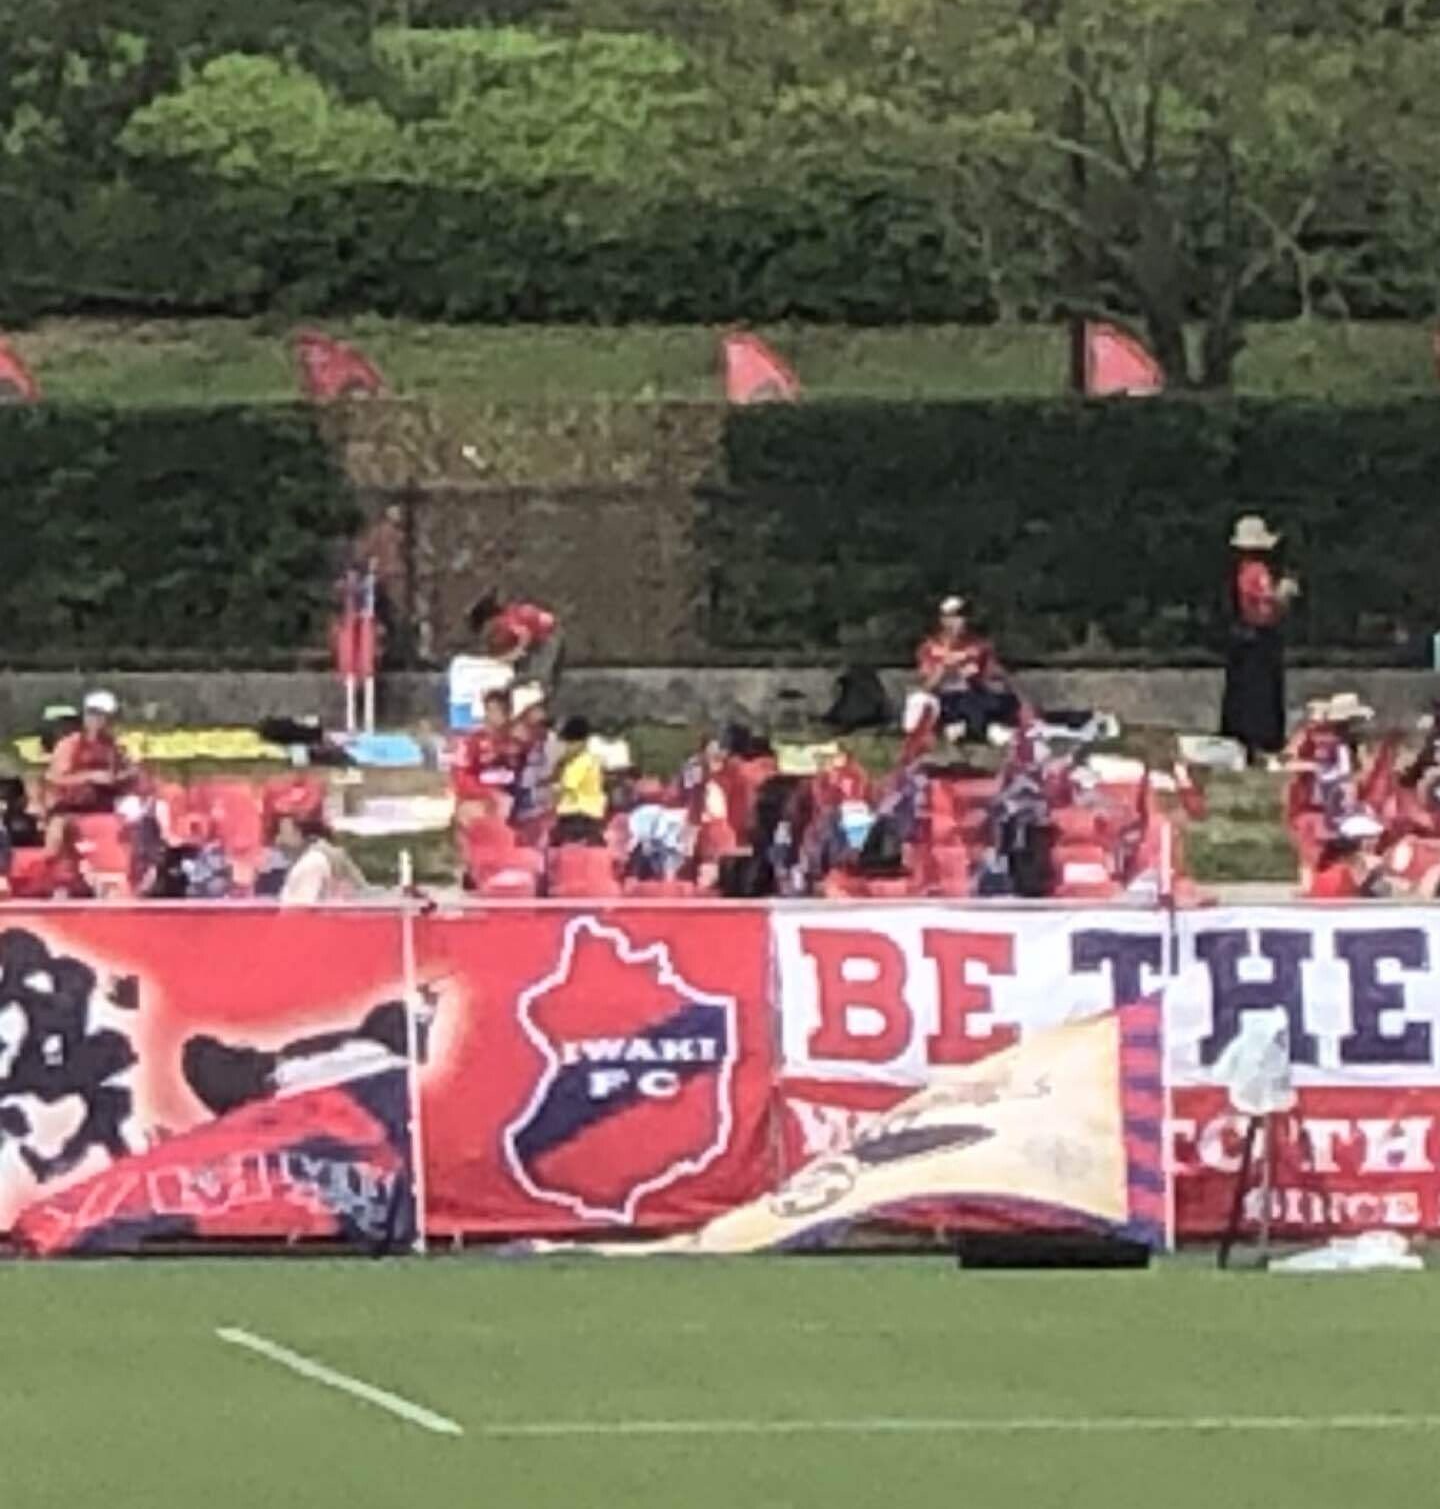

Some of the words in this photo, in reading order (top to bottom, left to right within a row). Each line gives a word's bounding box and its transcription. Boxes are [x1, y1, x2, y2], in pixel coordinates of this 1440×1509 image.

[799, 927, 1018, 1065] BE
[1070, 926, 1435, 1065] THE
[562, 1037, 717, 1066] IWAKI
[588, 1068, 681, 1099] FC
[1244, 1189, 1423, 1225] SINCE
